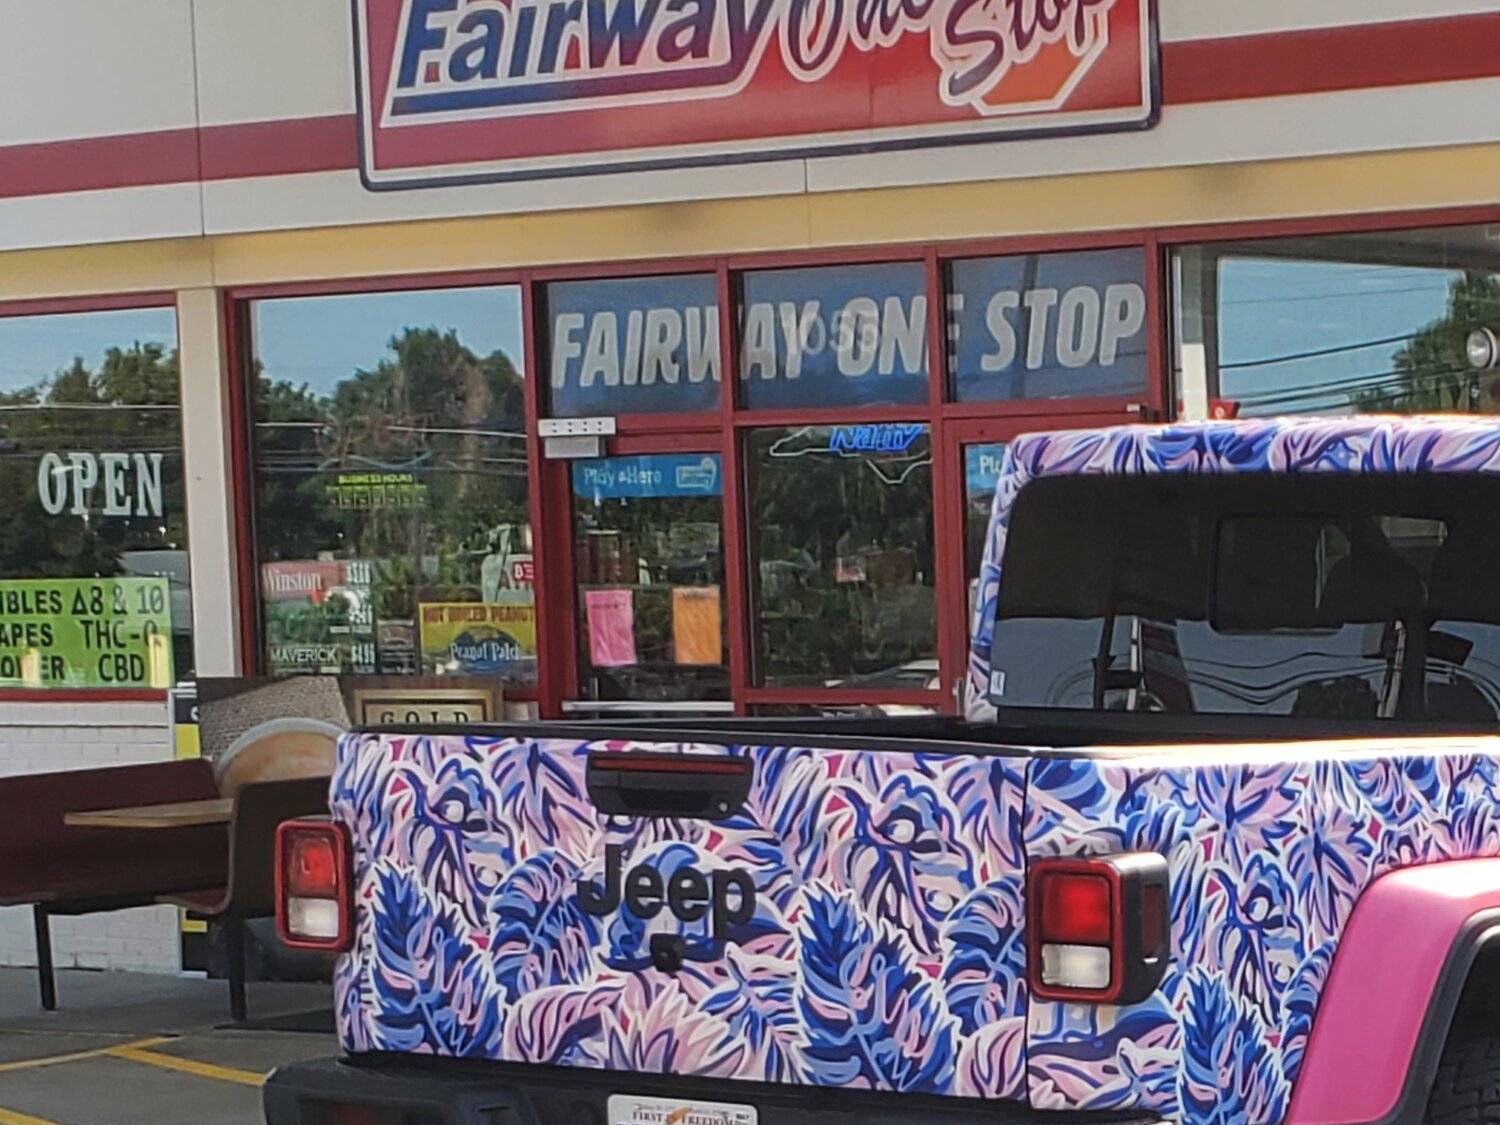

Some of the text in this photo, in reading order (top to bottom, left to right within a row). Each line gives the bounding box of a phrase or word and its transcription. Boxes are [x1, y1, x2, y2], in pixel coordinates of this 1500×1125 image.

[551, 301, 820, 389] FAIRWAY
[980, 283, 1146, 372] STOP
[38, 452, 164, 517] OPEN
[262, 568, 323, 592] Winston
[137, 585, 165, 615] 10
[0, 653, 145, 682] OER CBD
[271, 649, 337, 663] MAVERICK
[576, 843, 757, 940] Jeep
[633, 1110, 662, 1123] FIRST
